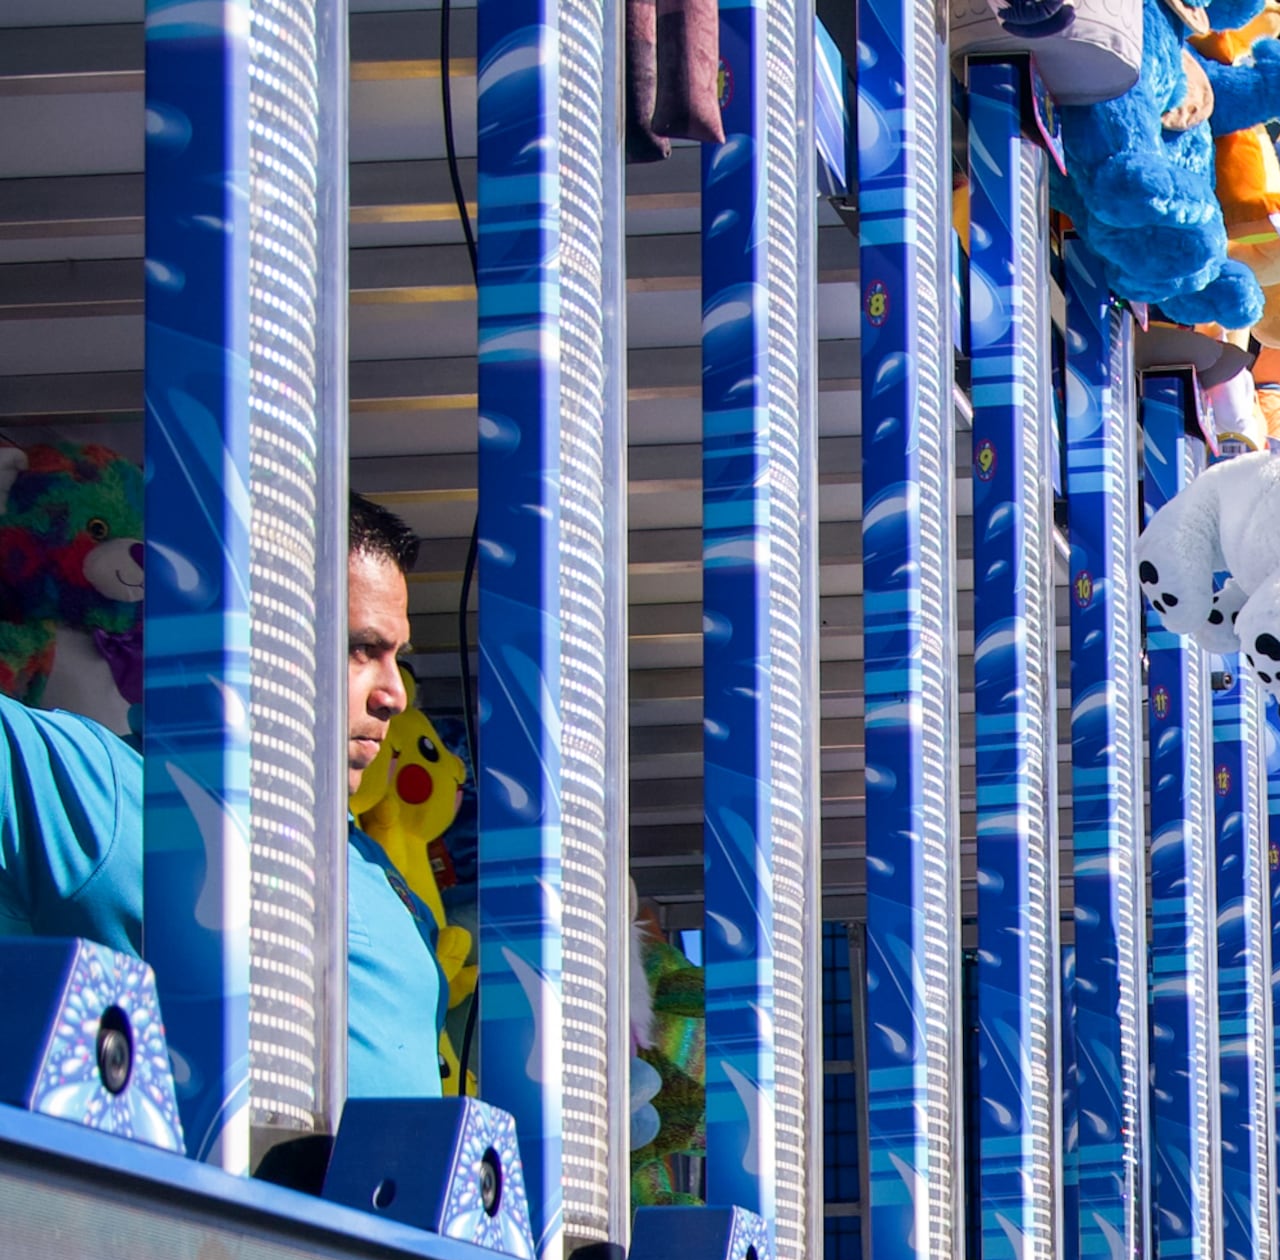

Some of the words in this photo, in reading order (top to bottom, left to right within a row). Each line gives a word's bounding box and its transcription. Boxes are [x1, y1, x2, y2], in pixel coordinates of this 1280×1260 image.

[869, 292, 885, 317] 8
[979, 448, 994, 473] 9
[1077, 578, 1090, 599] 10
